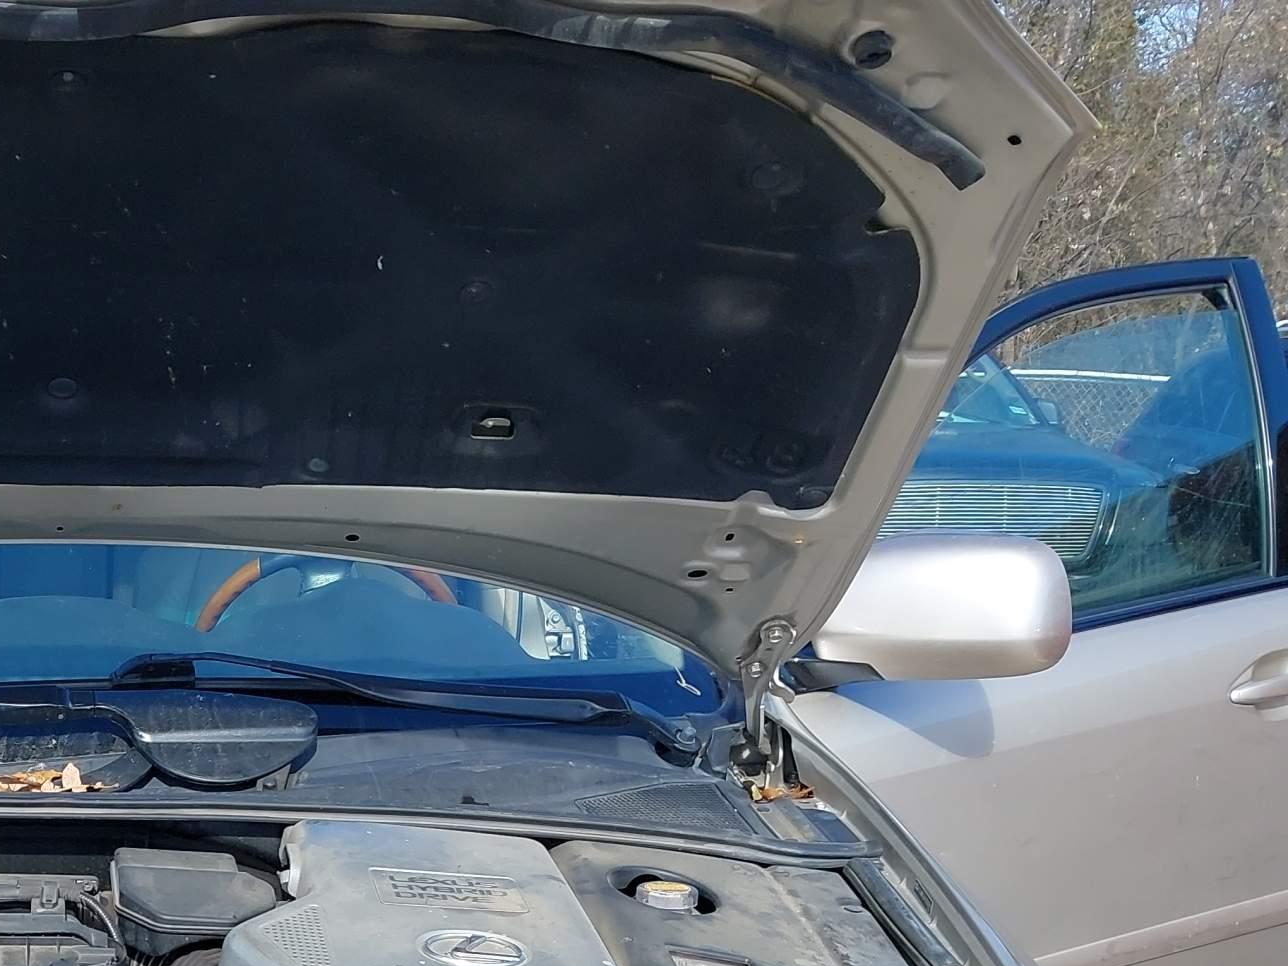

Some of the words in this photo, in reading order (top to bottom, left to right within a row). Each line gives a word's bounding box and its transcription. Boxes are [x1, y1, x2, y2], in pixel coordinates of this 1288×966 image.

[389, 875, 499, 888] LEXUS
[392, 883, 507, 896] HYBRID
[394, 891, 494, 903] DRIVE
